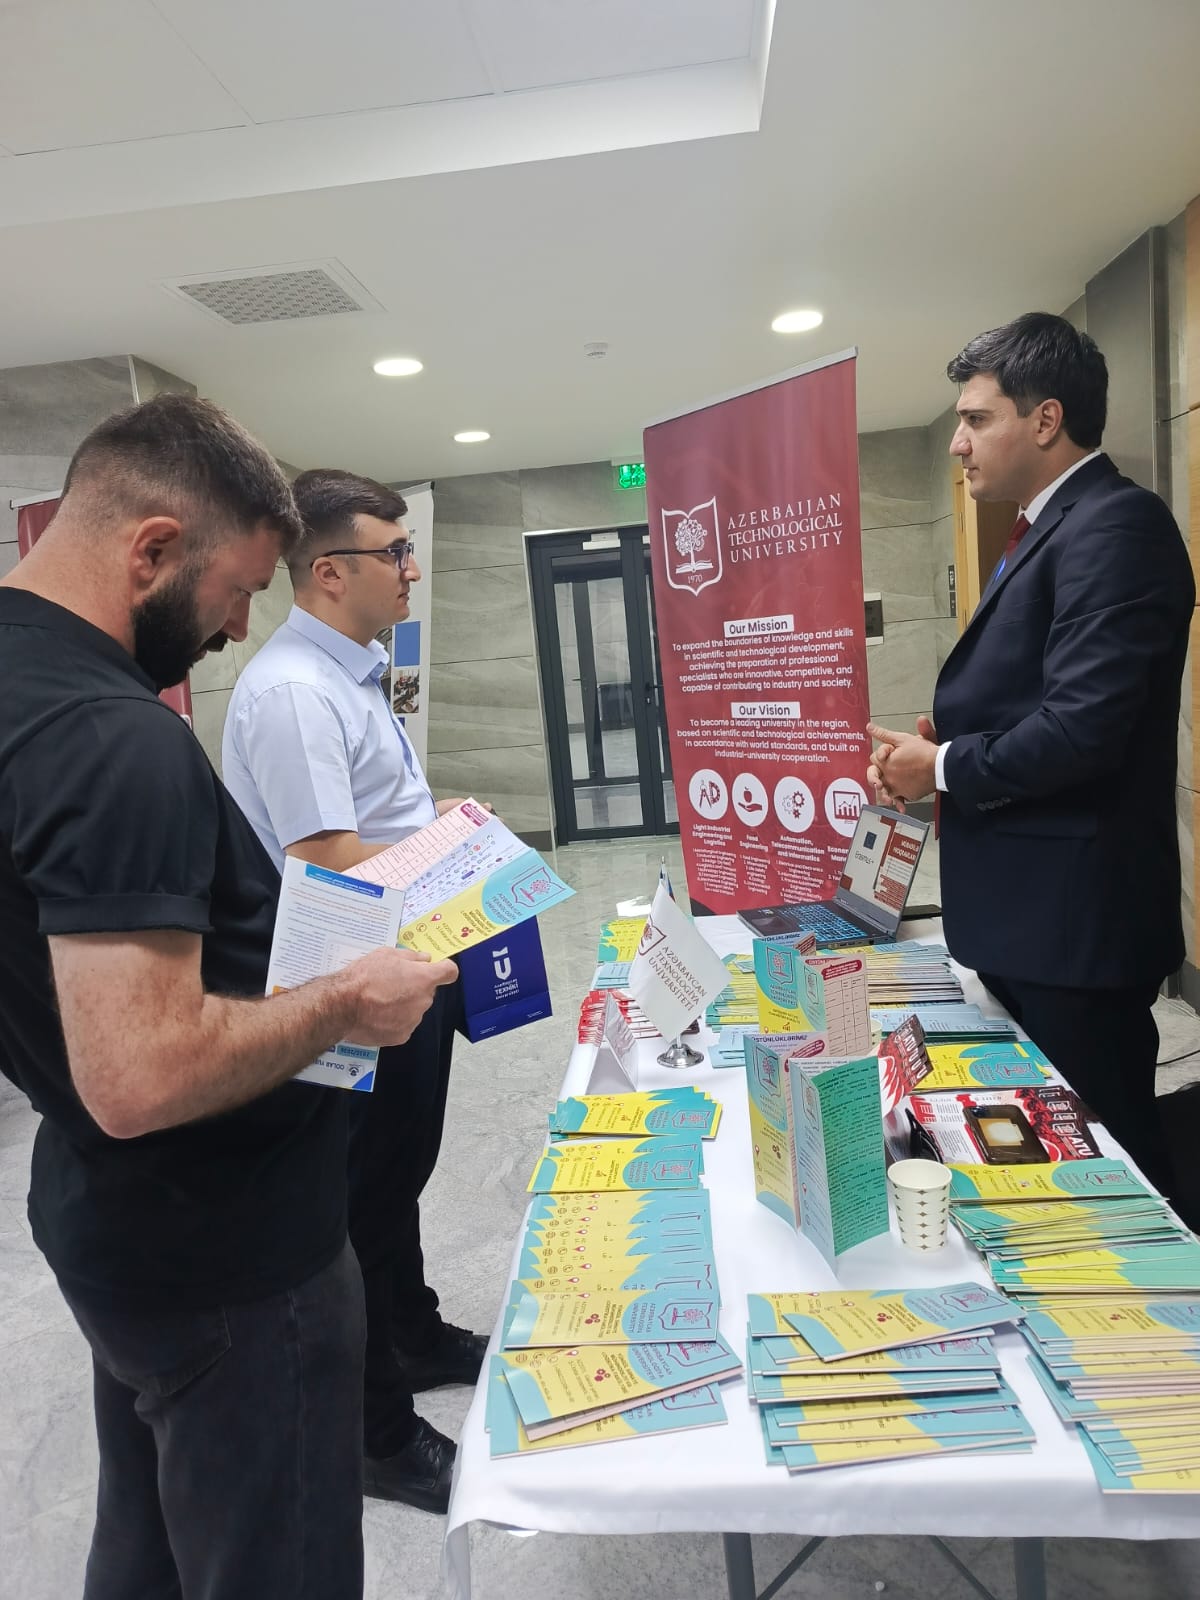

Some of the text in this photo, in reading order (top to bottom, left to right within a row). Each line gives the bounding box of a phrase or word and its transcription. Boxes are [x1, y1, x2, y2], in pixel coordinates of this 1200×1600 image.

[728, 493, 841, 530] AZERBAIJAN
[728, 513, 842, 546] TECHNOLOGICAL
[730, 531, 842, 563] UNIVERSITY
[730, 620, 788, 634] Our Mission
[682, 640, 710, 652] expand
[712, 640, 723, 648] the
[724, 637, 762, 646] boundaries
[772, 632, 813, 642] knowledge
[834, 628, 853, 637] skills
[692, 650, 724, 660] scientific
[739, 646, 786, 658] technological
[788, 642, 845, 655] development,
[689, 662, 725, 671] achieving
[737, 658, 778, 669] preparation
[780, 657, 786, 665] of
[789, 654, 839, 665] professional
[679, 672, 717, 683] specialists
[785, 667, 834, 678] competitive,
[836, 665, 852, 674] and
[682, 683, 712, 693] capable
[722, 681, 762, 692] contributing
[772, 680, 802, 690] industry
[822, 678, 853, 688] society.
[739, 705, 790, 715] Our Vision
[735, 720, 759, 729] leading
[761, 720, 796, 728] university
[821, 720, 850, 729] region,
[756, 731, 805, 740] technological
[807, 731, 865, 740] achievements,
[750, 741, 769, 749] world
[770, 741, 809, 750] standards,
[828, 743, 848, 751] built
[782, 754, 830, 763] cooperation.
[656, 951, 699, 1005] TEXNOLOGİYA
[662, 946, 707, 997] AZƏRBAYCAN
[903, 1034, 916, 1051] ATU
[1068, 1138, 1094, 1156] ATU
